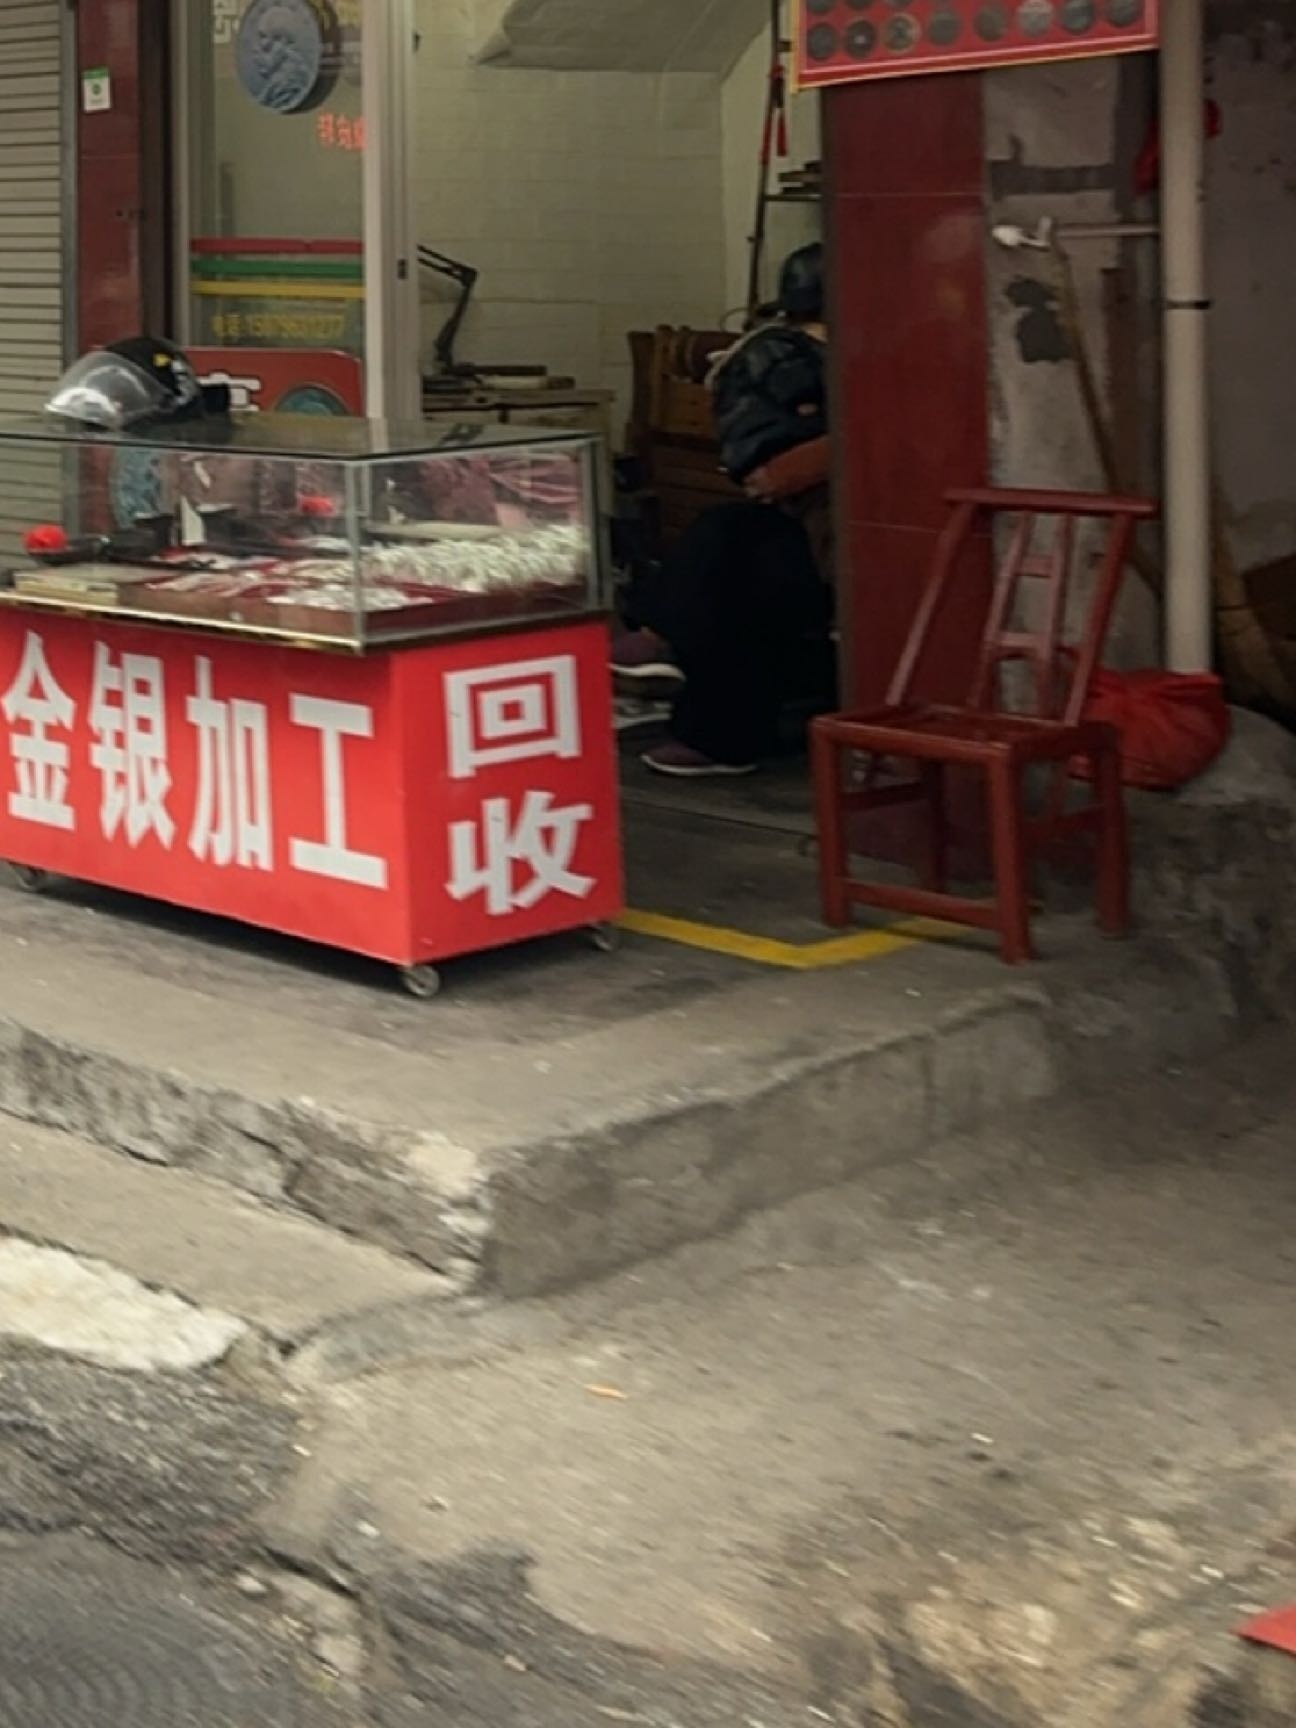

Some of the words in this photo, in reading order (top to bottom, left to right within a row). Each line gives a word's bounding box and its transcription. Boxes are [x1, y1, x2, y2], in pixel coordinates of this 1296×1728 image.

[0, 630, 389, 890] 金银加工
[442, 654, 597, 915] 回收
